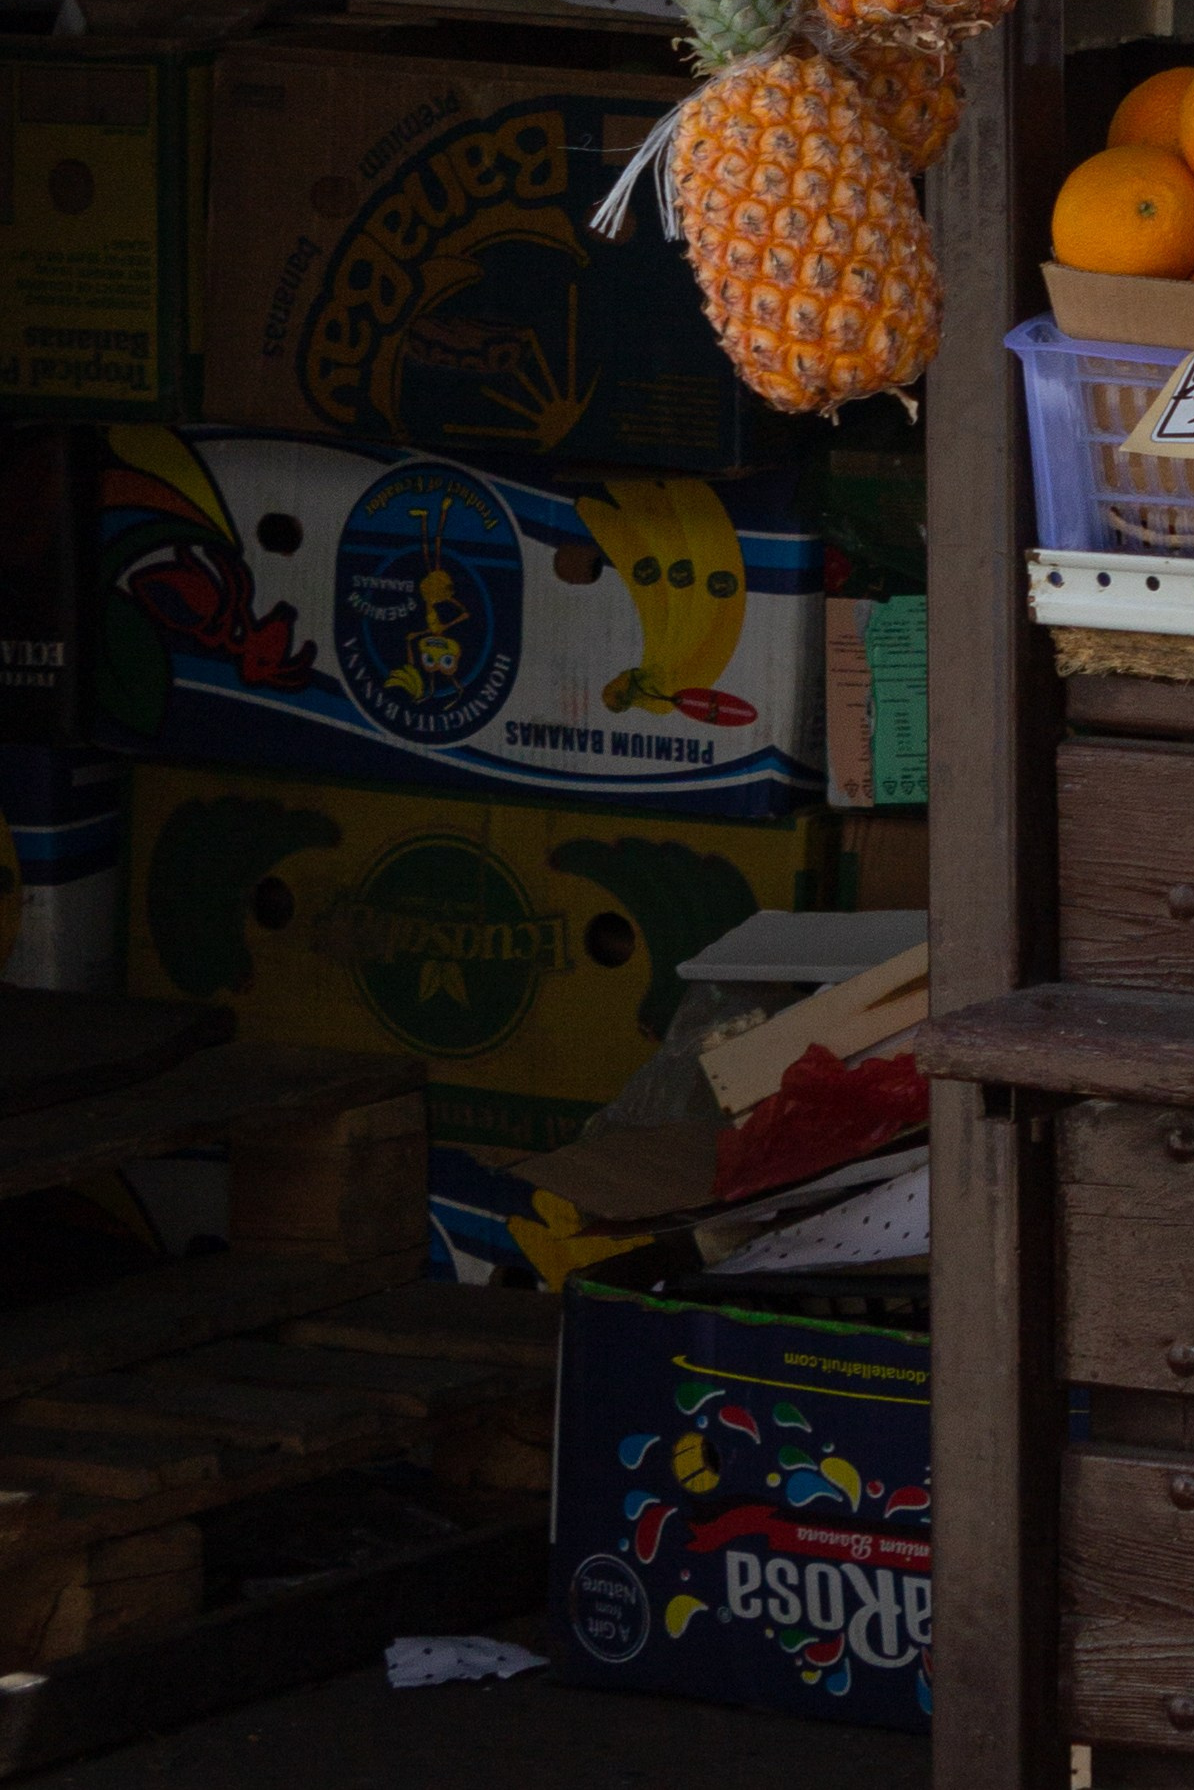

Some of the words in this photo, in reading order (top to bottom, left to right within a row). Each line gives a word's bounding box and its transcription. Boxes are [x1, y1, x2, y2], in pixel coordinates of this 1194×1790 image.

[24, 327, 149, 359] Bananas
[31, 352, 149, 390] Tropical
[364, 477, 424, 520] Ecuador
[427, 476, 444, 495] of
[445, 481, 499, 530] Product
[351, 574, 415, 593] BANANAS
[346, 590, 417, 622] PREMIUM
[341, 636, 402, 721] BANANA
[403, 652, 512, 734] HORMIGUITA
[504, 721, 604, 754] BANANAS
[611, 731, 714, 765] PREMIUM
[796, 1527, 873, 1561] Banana
[580, 1576, 638, 1603] Nature
[594, 1601, 623, 1620] from
[587, 1617, 617, 1642] Gift
[618, 1624, 631, 1643] A
